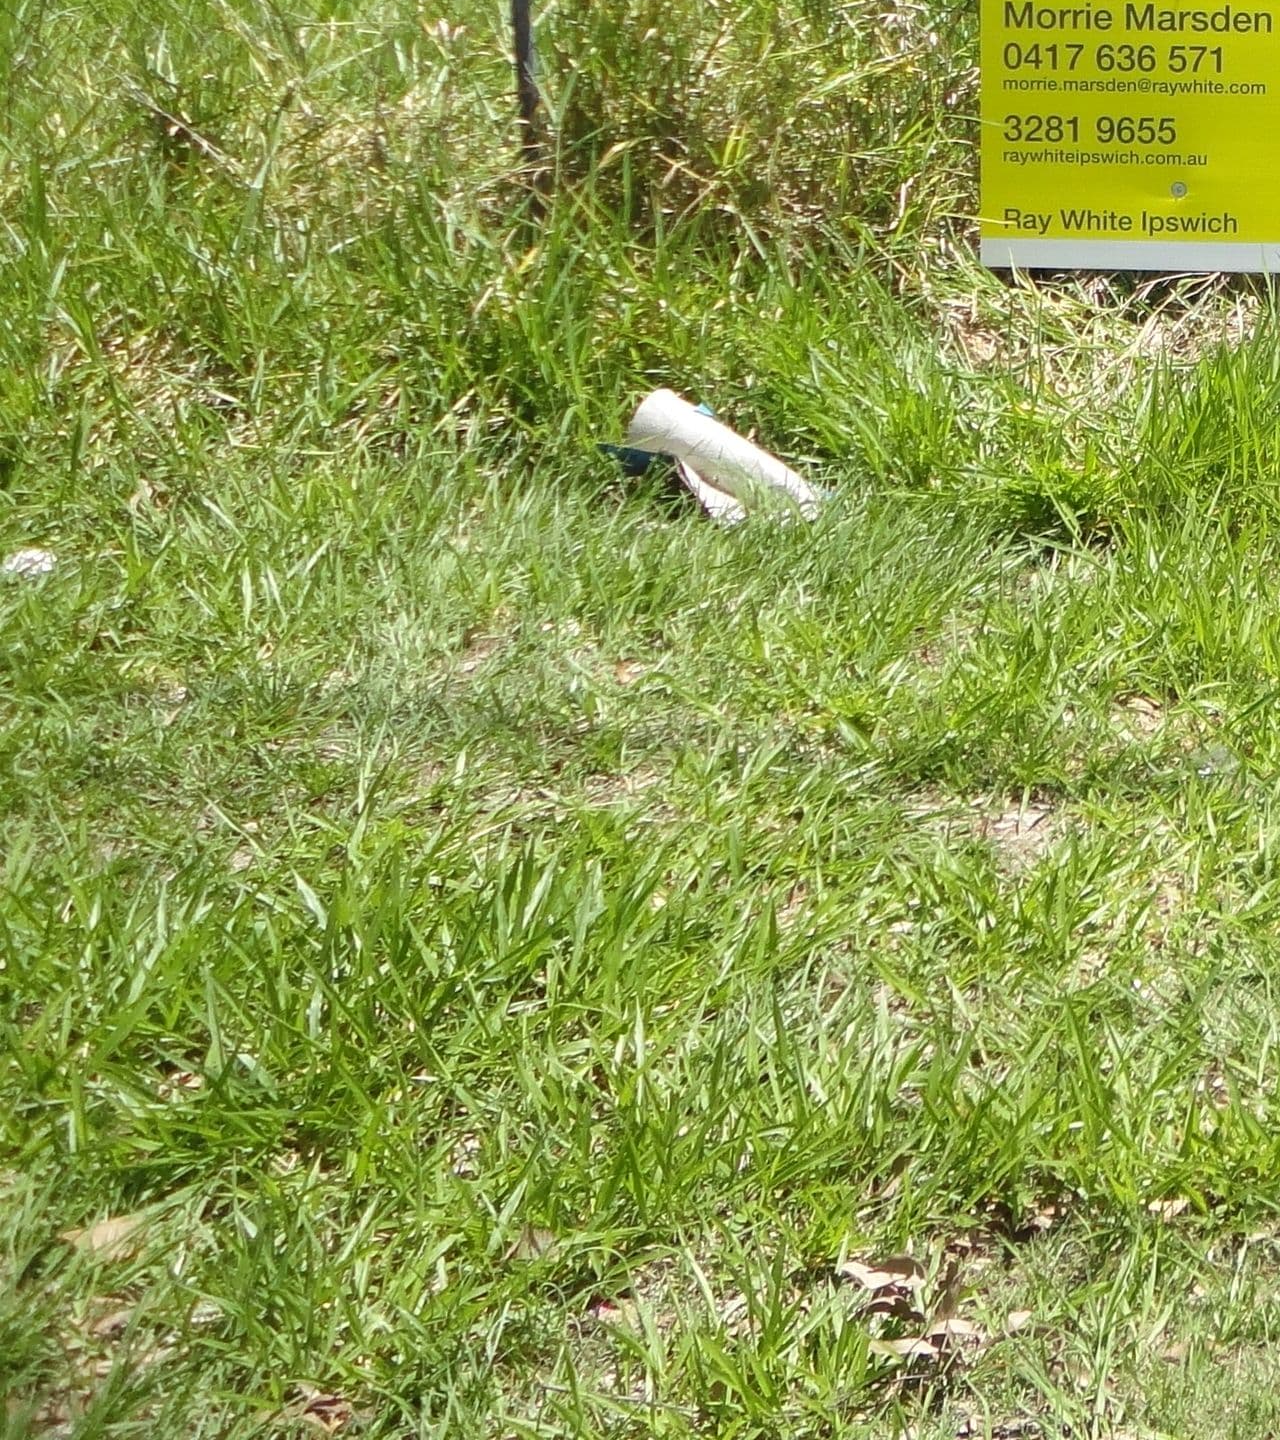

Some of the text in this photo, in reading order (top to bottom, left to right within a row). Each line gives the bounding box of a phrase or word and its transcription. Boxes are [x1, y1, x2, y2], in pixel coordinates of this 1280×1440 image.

[1003, 0, 1272, 33] Morrie Marsden
[1003, 43, 1223, 74] 0417 636 571
[1002, 77, 1266, 96] morrie.marsden@raywhite.com
[1003, 114, 1177, 145] 3281 9655
[1003, 148, 1208, 167] raywhiteipswich.com.au
[1004, 208, 1237, 237] Ray White Ipswich
